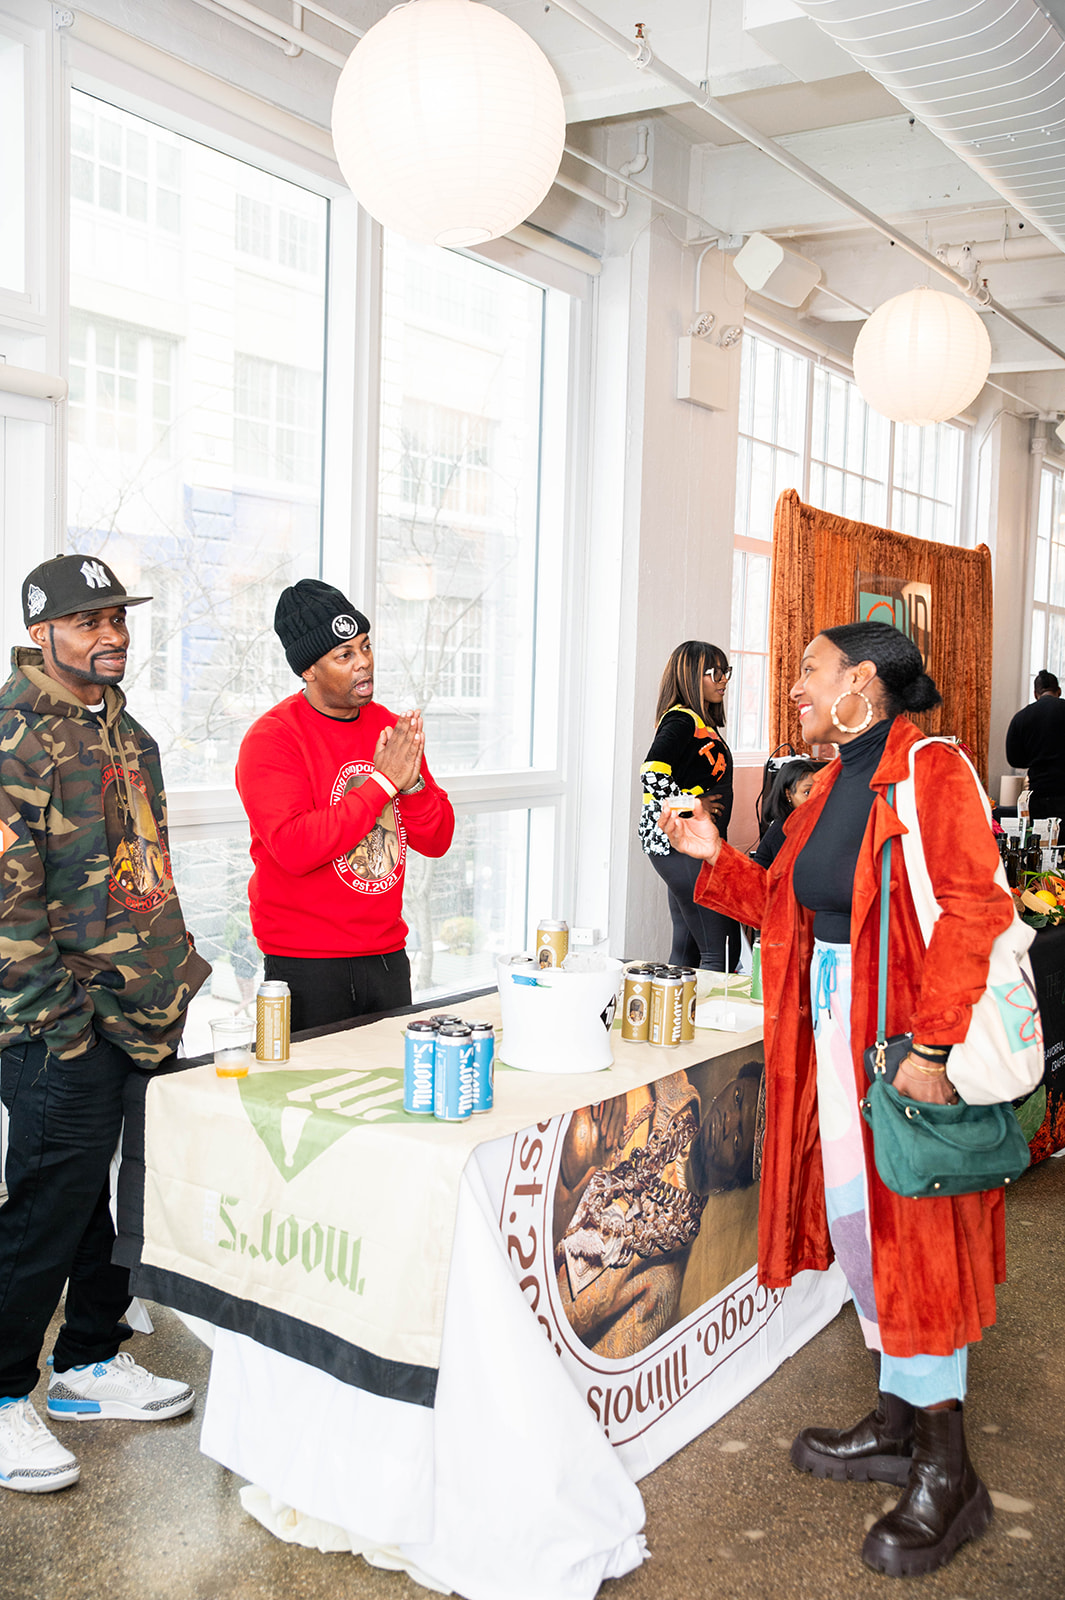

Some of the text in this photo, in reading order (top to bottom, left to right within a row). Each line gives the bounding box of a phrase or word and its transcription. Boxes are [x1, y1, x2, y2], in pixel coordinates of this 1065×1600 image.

[80, 560, 112, 589] NY
[342, 763, 375, 779] compa
[352, 872, 398, 893] est.2021
[586, 1345, 689, 1440] illinois
